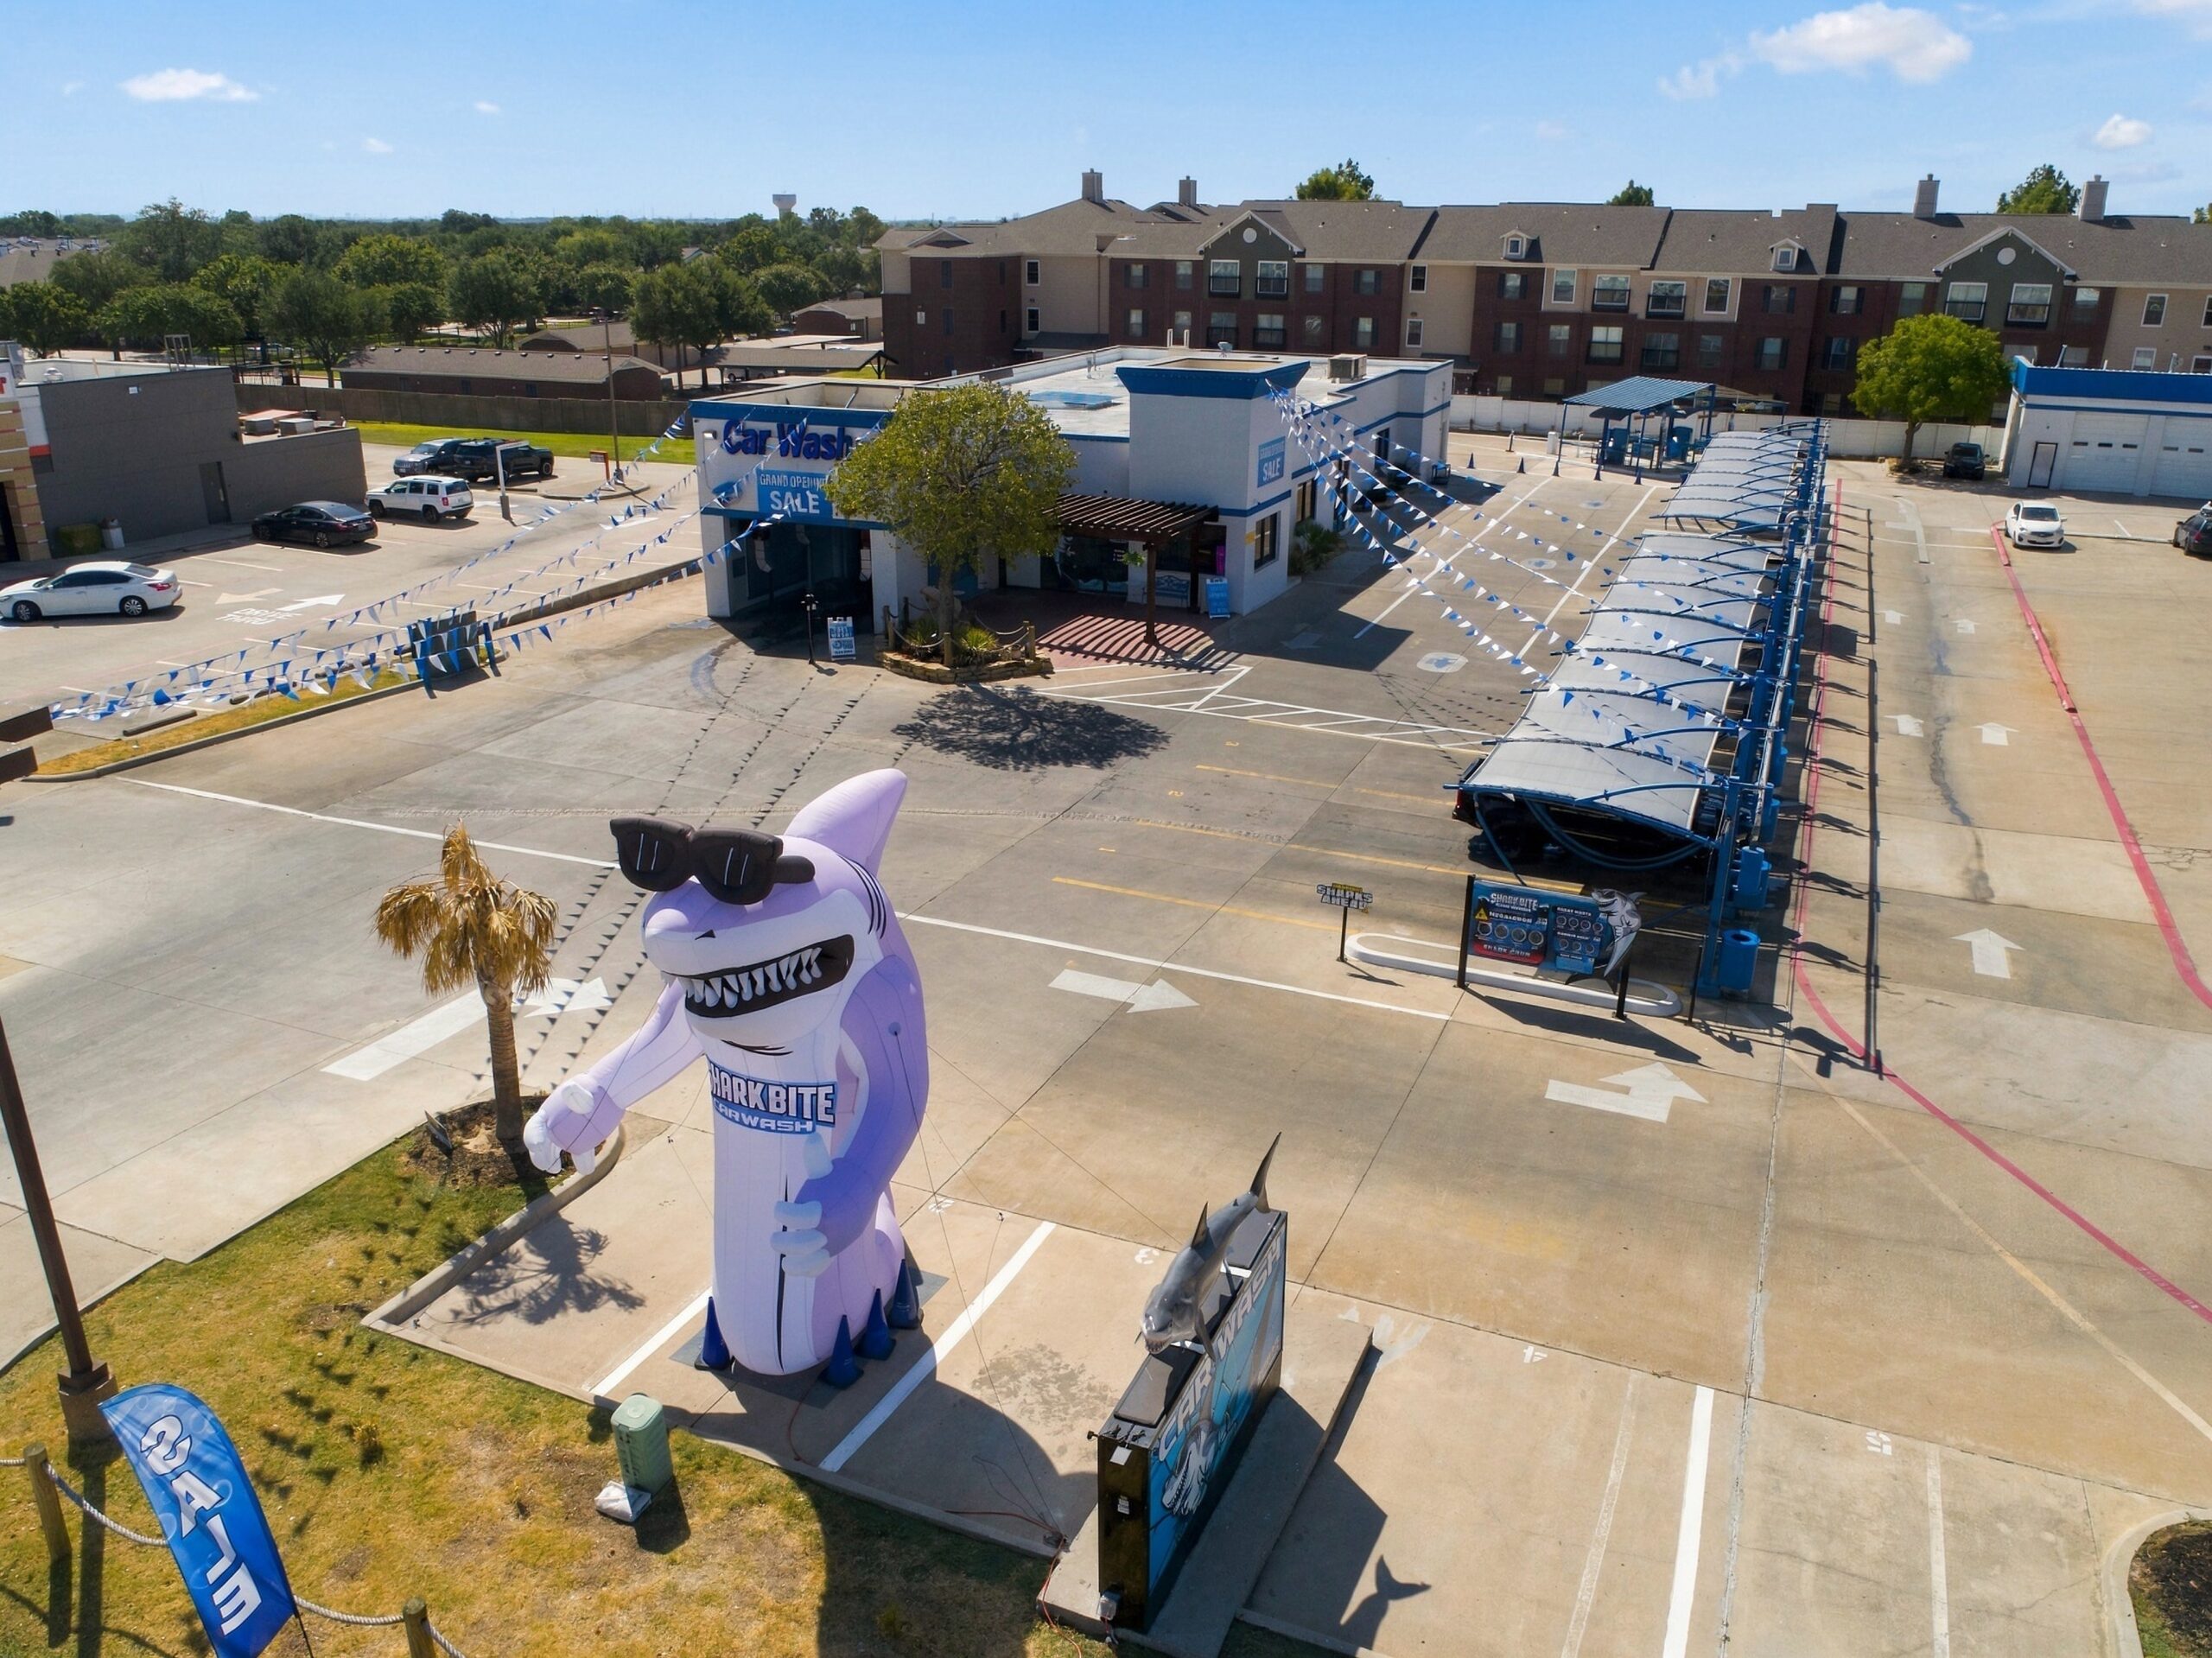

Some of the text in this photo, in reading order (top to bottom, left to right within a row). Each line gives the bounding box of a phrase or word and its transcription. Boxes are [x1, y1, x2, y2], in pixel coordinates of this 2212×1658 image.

[723, 419, 852, 461] Car Wash
[1262, 457, 1281, 483] SALE
[760, 473, 827, 490] GRAND OPENIN
[770, 490, 820, 514] SALE
[1316, 884, 1373, 904] SHARKS
[1321, 893, 1366, 911] AHEAD
[1491, 893, 1538, 912] SHARK BITE
[709, 1064, 835, 1124] HARK BITE
[1134, 1248, 1160, 1265] 3
[1159, 1356, 1212, 1462] CAR
[1215, 1239, 1281, 1363] WASH
[1522, 1345, 1548, 1363] 4
[139, 1414, 262, 1636] SALE
